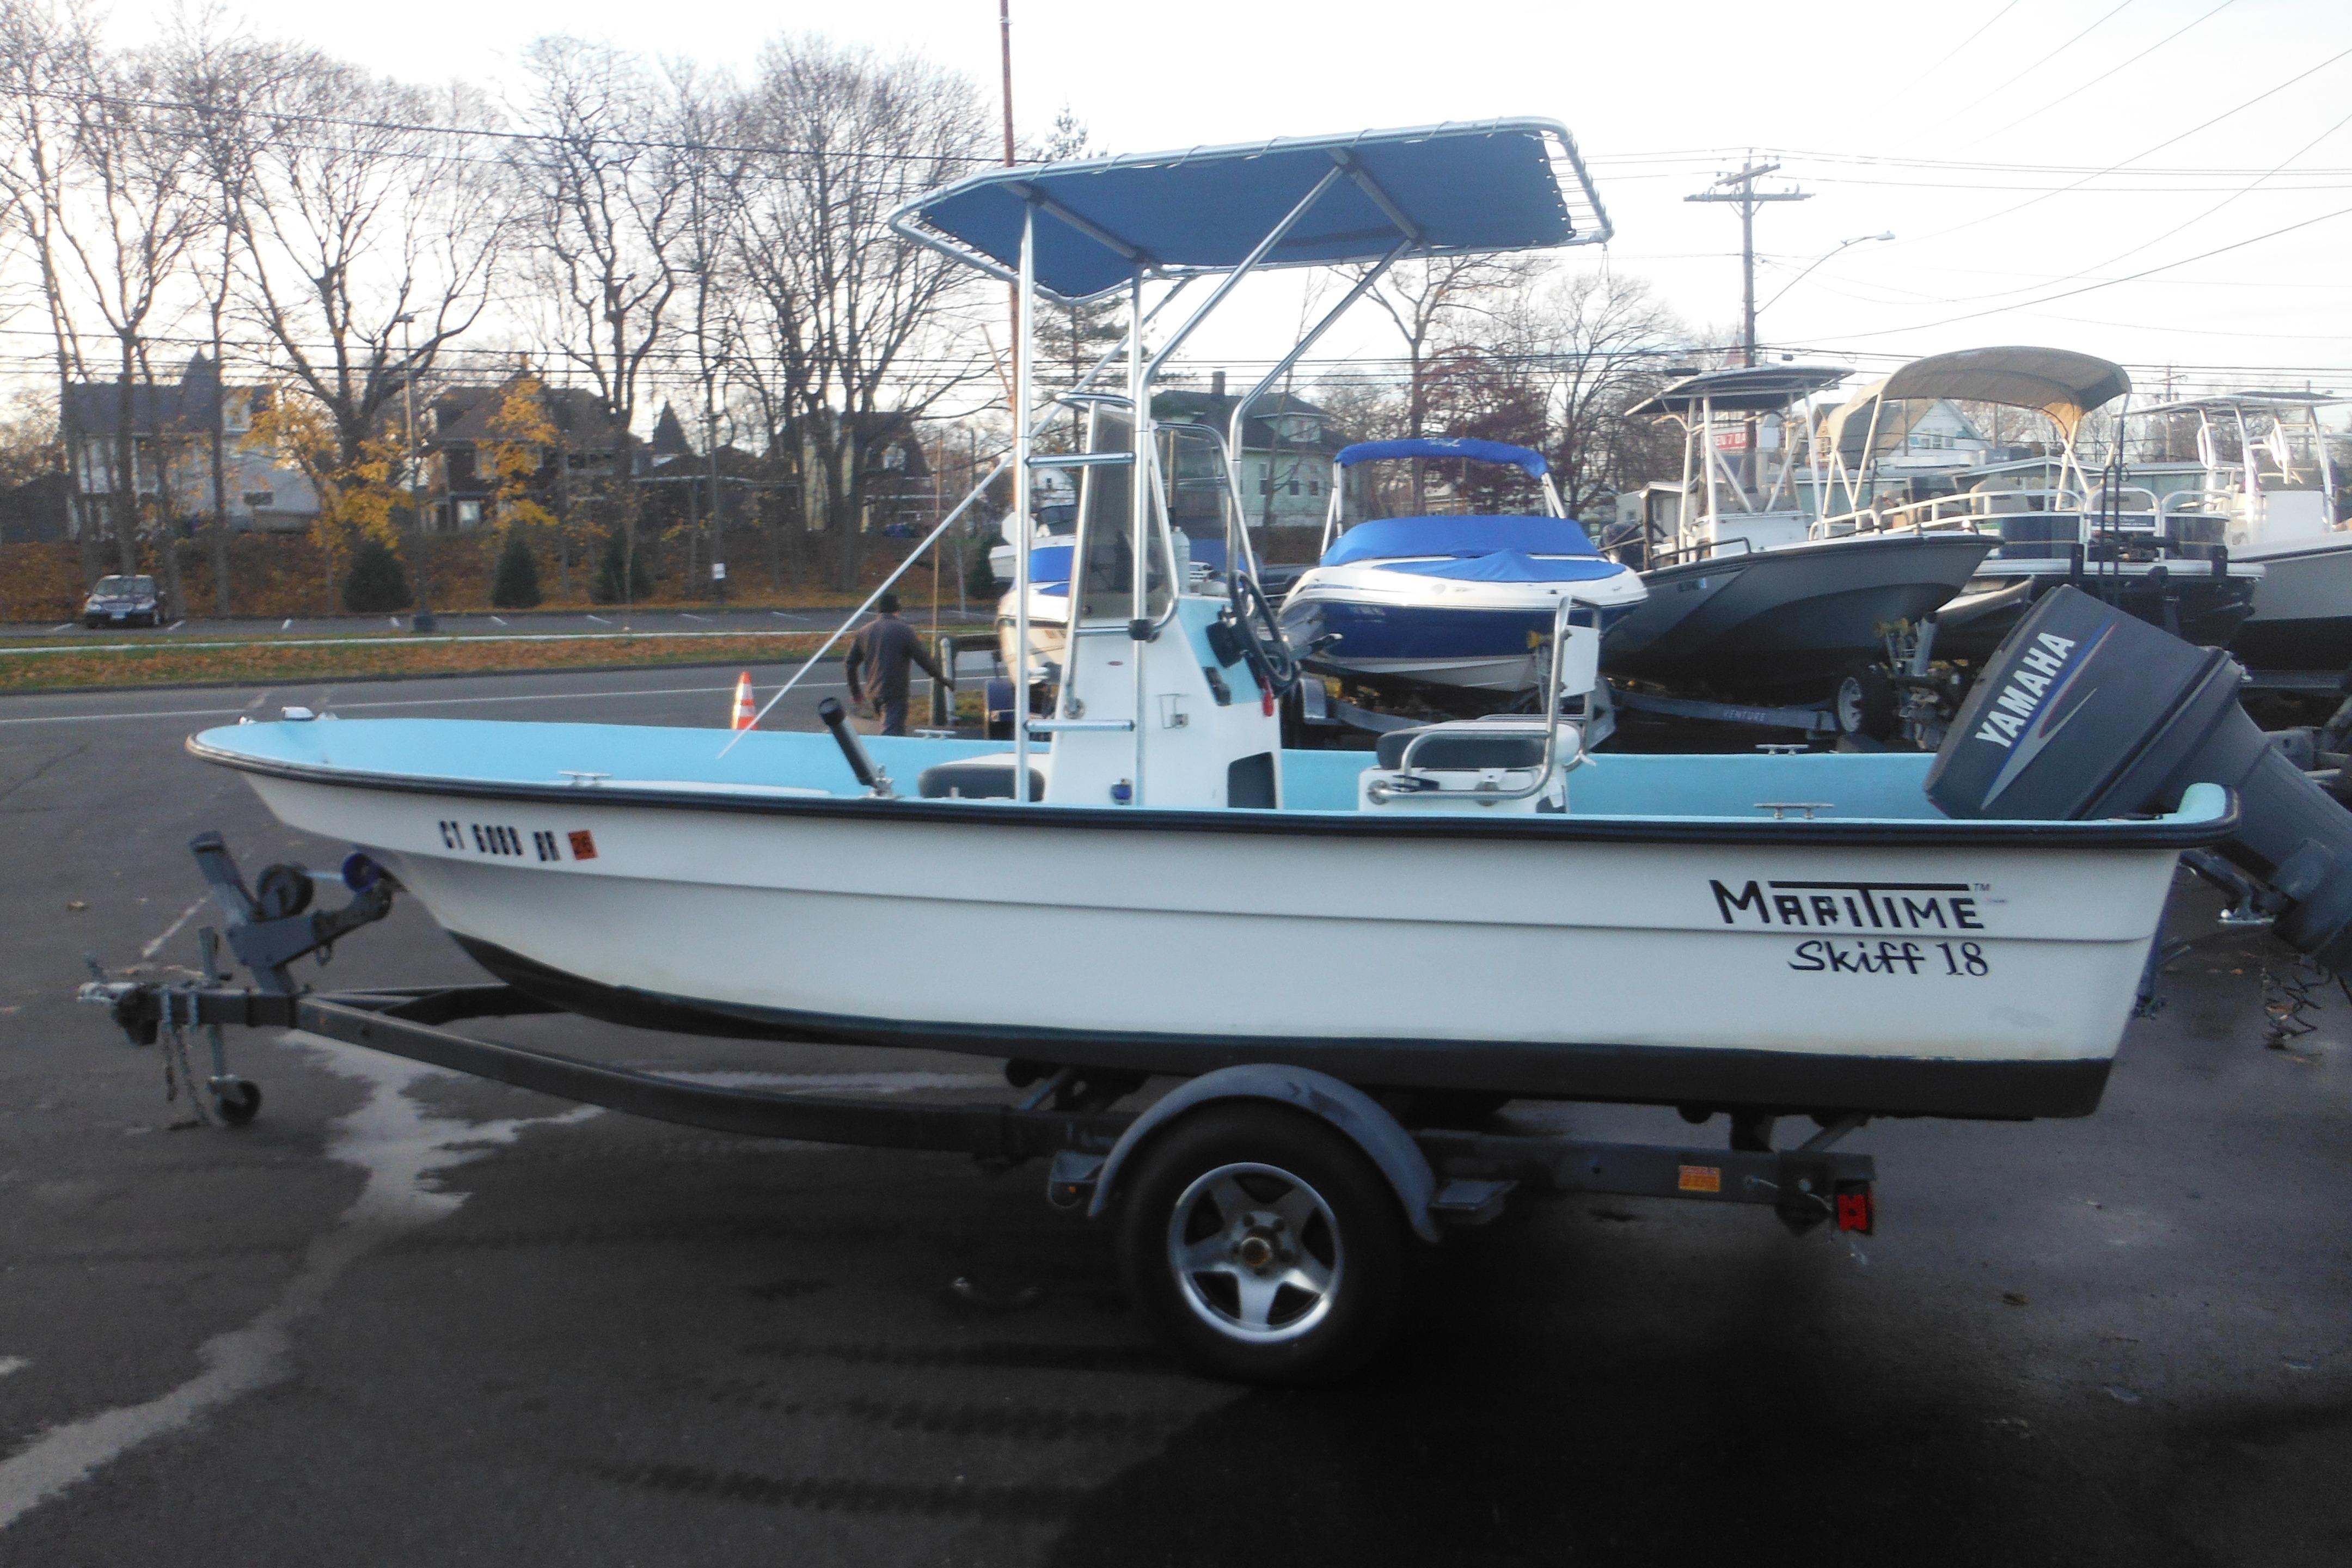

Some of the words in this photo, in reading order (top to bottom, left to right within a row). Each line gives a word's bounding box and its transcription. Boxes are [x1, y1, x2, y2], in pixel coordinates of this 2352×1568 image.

[1975, 632, 2076, 748] YAMAHA
[1709, 879, 1984, 928] MARITIME
[1787, 940, 1925, 974] Skiff
[1936, 941, 1989, 976] 18
